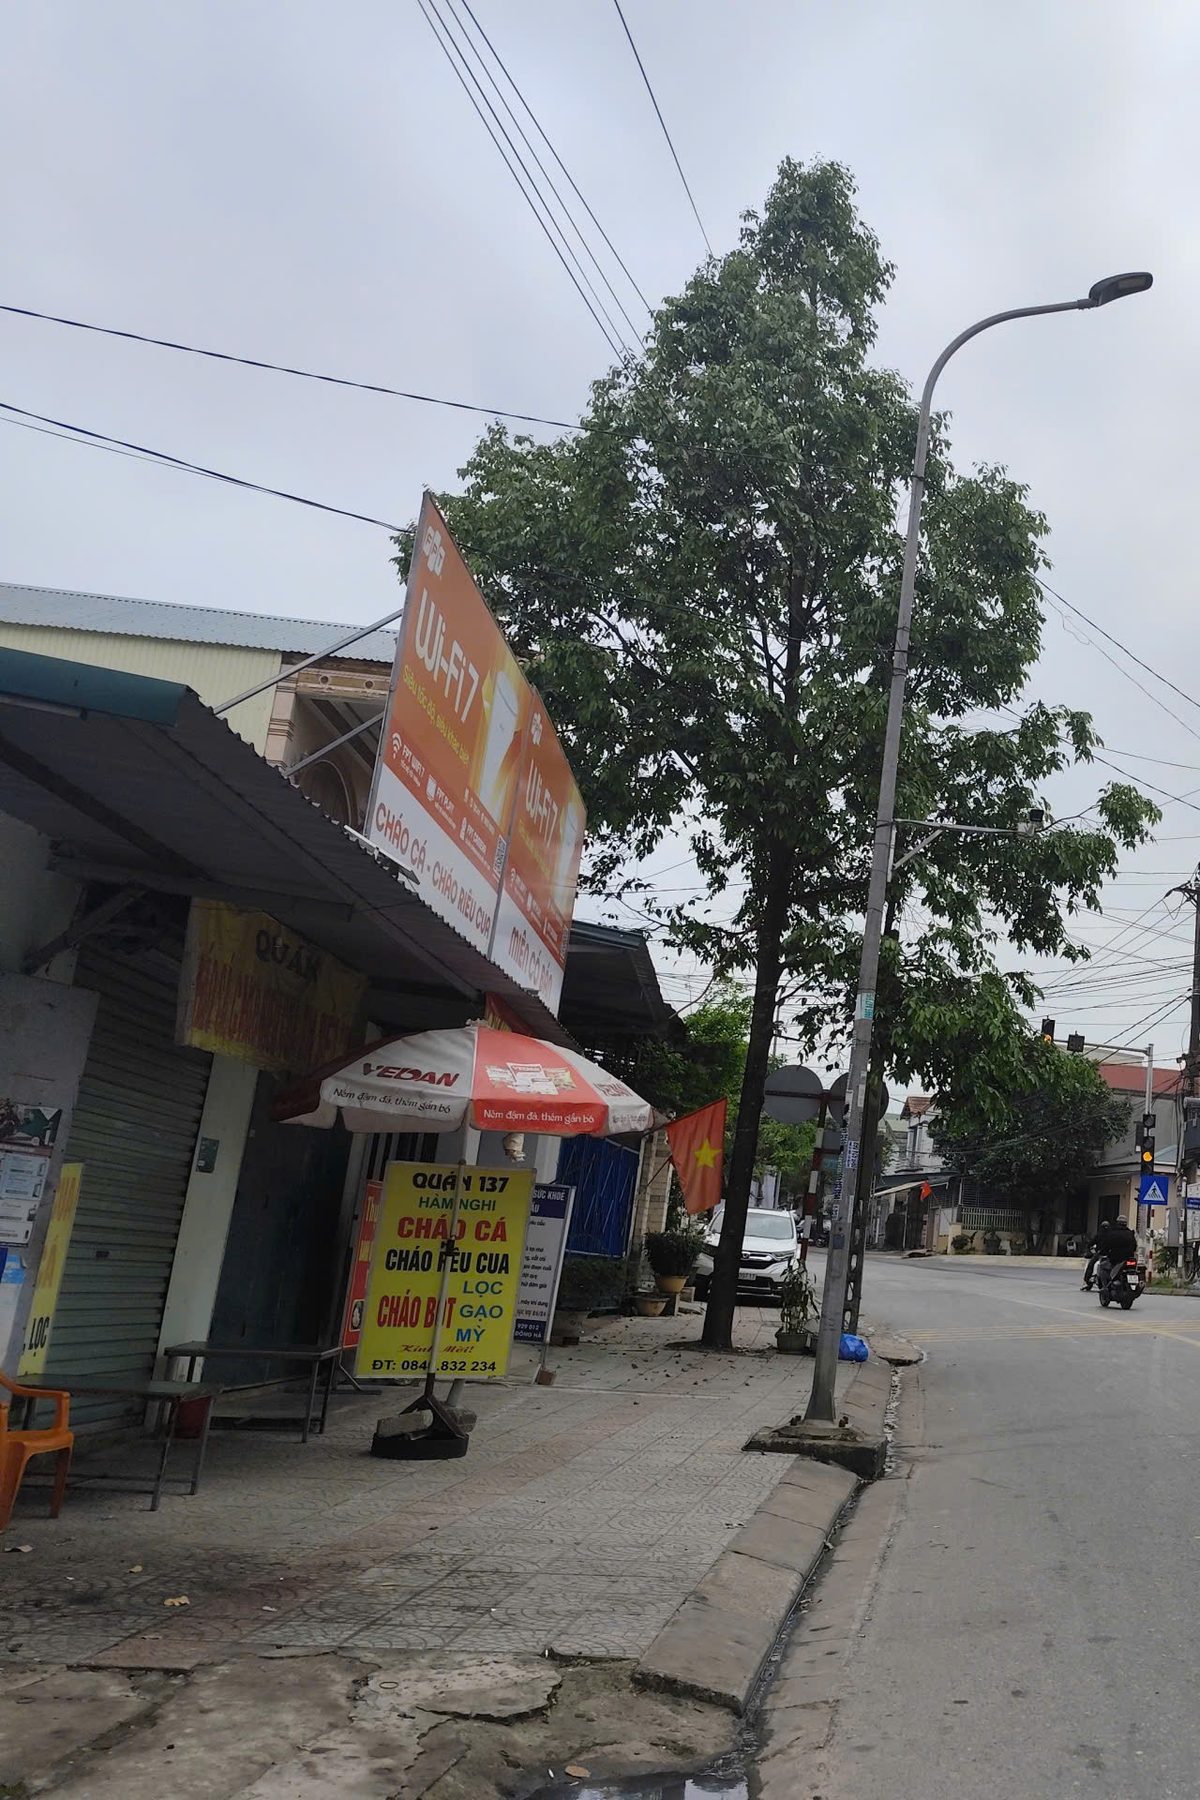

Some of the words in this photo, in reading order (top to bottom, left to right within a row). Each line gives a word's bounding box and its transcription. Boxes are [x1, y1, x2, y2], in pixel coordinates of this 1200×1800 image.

[376, 802, 409, 855] CHÁO
[411, 838, 428, 874] CÁ
[432, 860, 458, 904] CHÁO
[363, 1063, 460, 1087] VEDAN
[412, 1171, 473, 1192] QUÁN
[479, 1176, 510, 1193] 137
[419, 1193, 454, 1210] HÀM
[458, 1199, 497, 1212] NGHI
[474, 1216, 508, 1242] CÁ
[385, 1245, 433, 1272] CHÁO
[436, 1246, 472, 1273] RÊU
[475, 1252, 510, 1275] CUA
[462, 1280, 504, 1299] LỌC
[376, 1288, 422, 1328] CHÁO
[423, 1296, 457, 1329] BT
[459, 1304, 504, 1323] GẠO
[455, 1324, 486, 1343] MỲ
[372, 1359, 397, 1371] ĐT:
[401, 1360, 466, 1372] 084.832
[470, 1361, 496, 1372] 234
